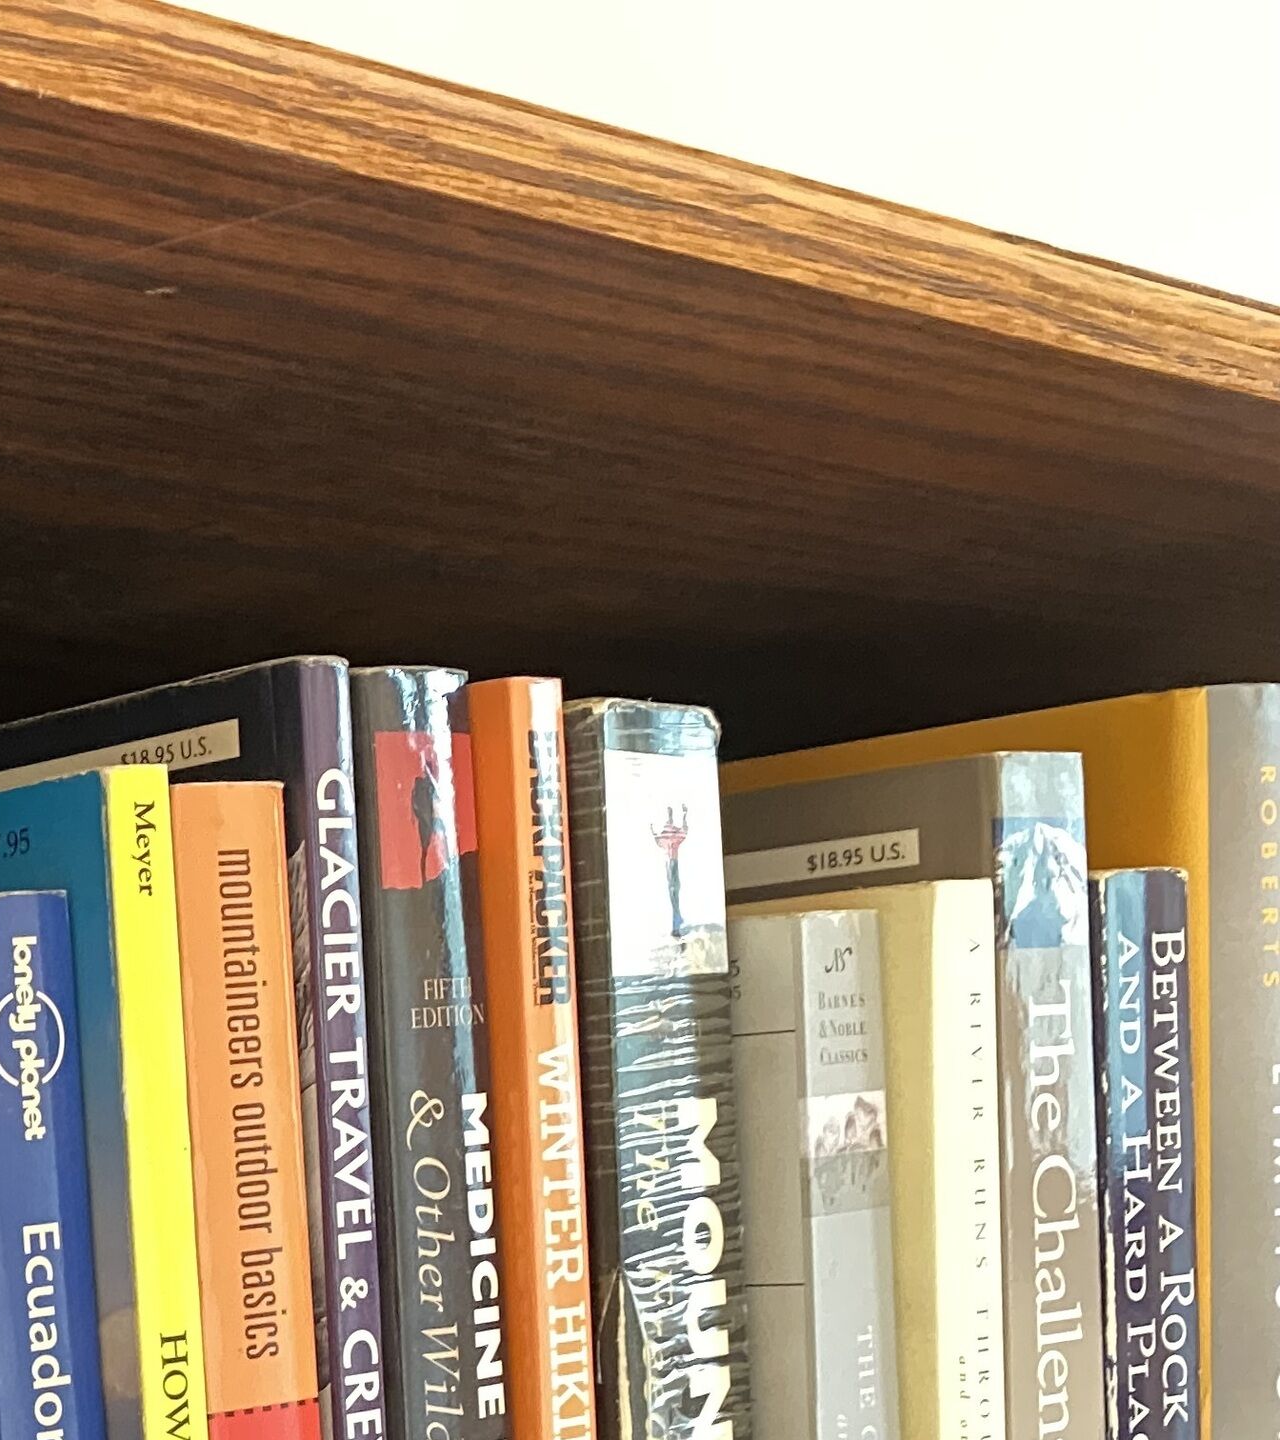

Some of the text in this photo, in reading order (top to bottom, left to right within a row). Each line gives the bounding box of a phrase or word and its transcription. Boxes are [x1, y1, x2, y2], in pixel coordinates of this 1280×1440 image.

[132, 799, 157, 898] Meyer
[315, 768, 361, 1021] GLACIER
[807, 840, 906, 874] $18.95 U.S.
[8, 935, 47, 1142] lonely planet
[410, 1001, 486, 1030] EDITION
[423, 975, 473, 1001] FIFTH
[1028, 977, 1077, 1132] The
[1117, 931, 1141, 1057] AND
[216, 848, 288, 1361] mountaineers outdoor basics
[327, 1036, 378, 1261] TRAVEL
[536, 1041, 586, 1290] WINTER
[1121, 1077, 1144, 1114] A
[412, 1156, 456, 1313] Other
[1122, 1129, 1153, 1303] HARD
[1151, 926, 1195, 1428] BETWEEN A ROCK
[340, 1276, 370, 1312] &
[461, 1091, 507, 1420] MEDICINE
[856, 1324, 877, 1410] THE
